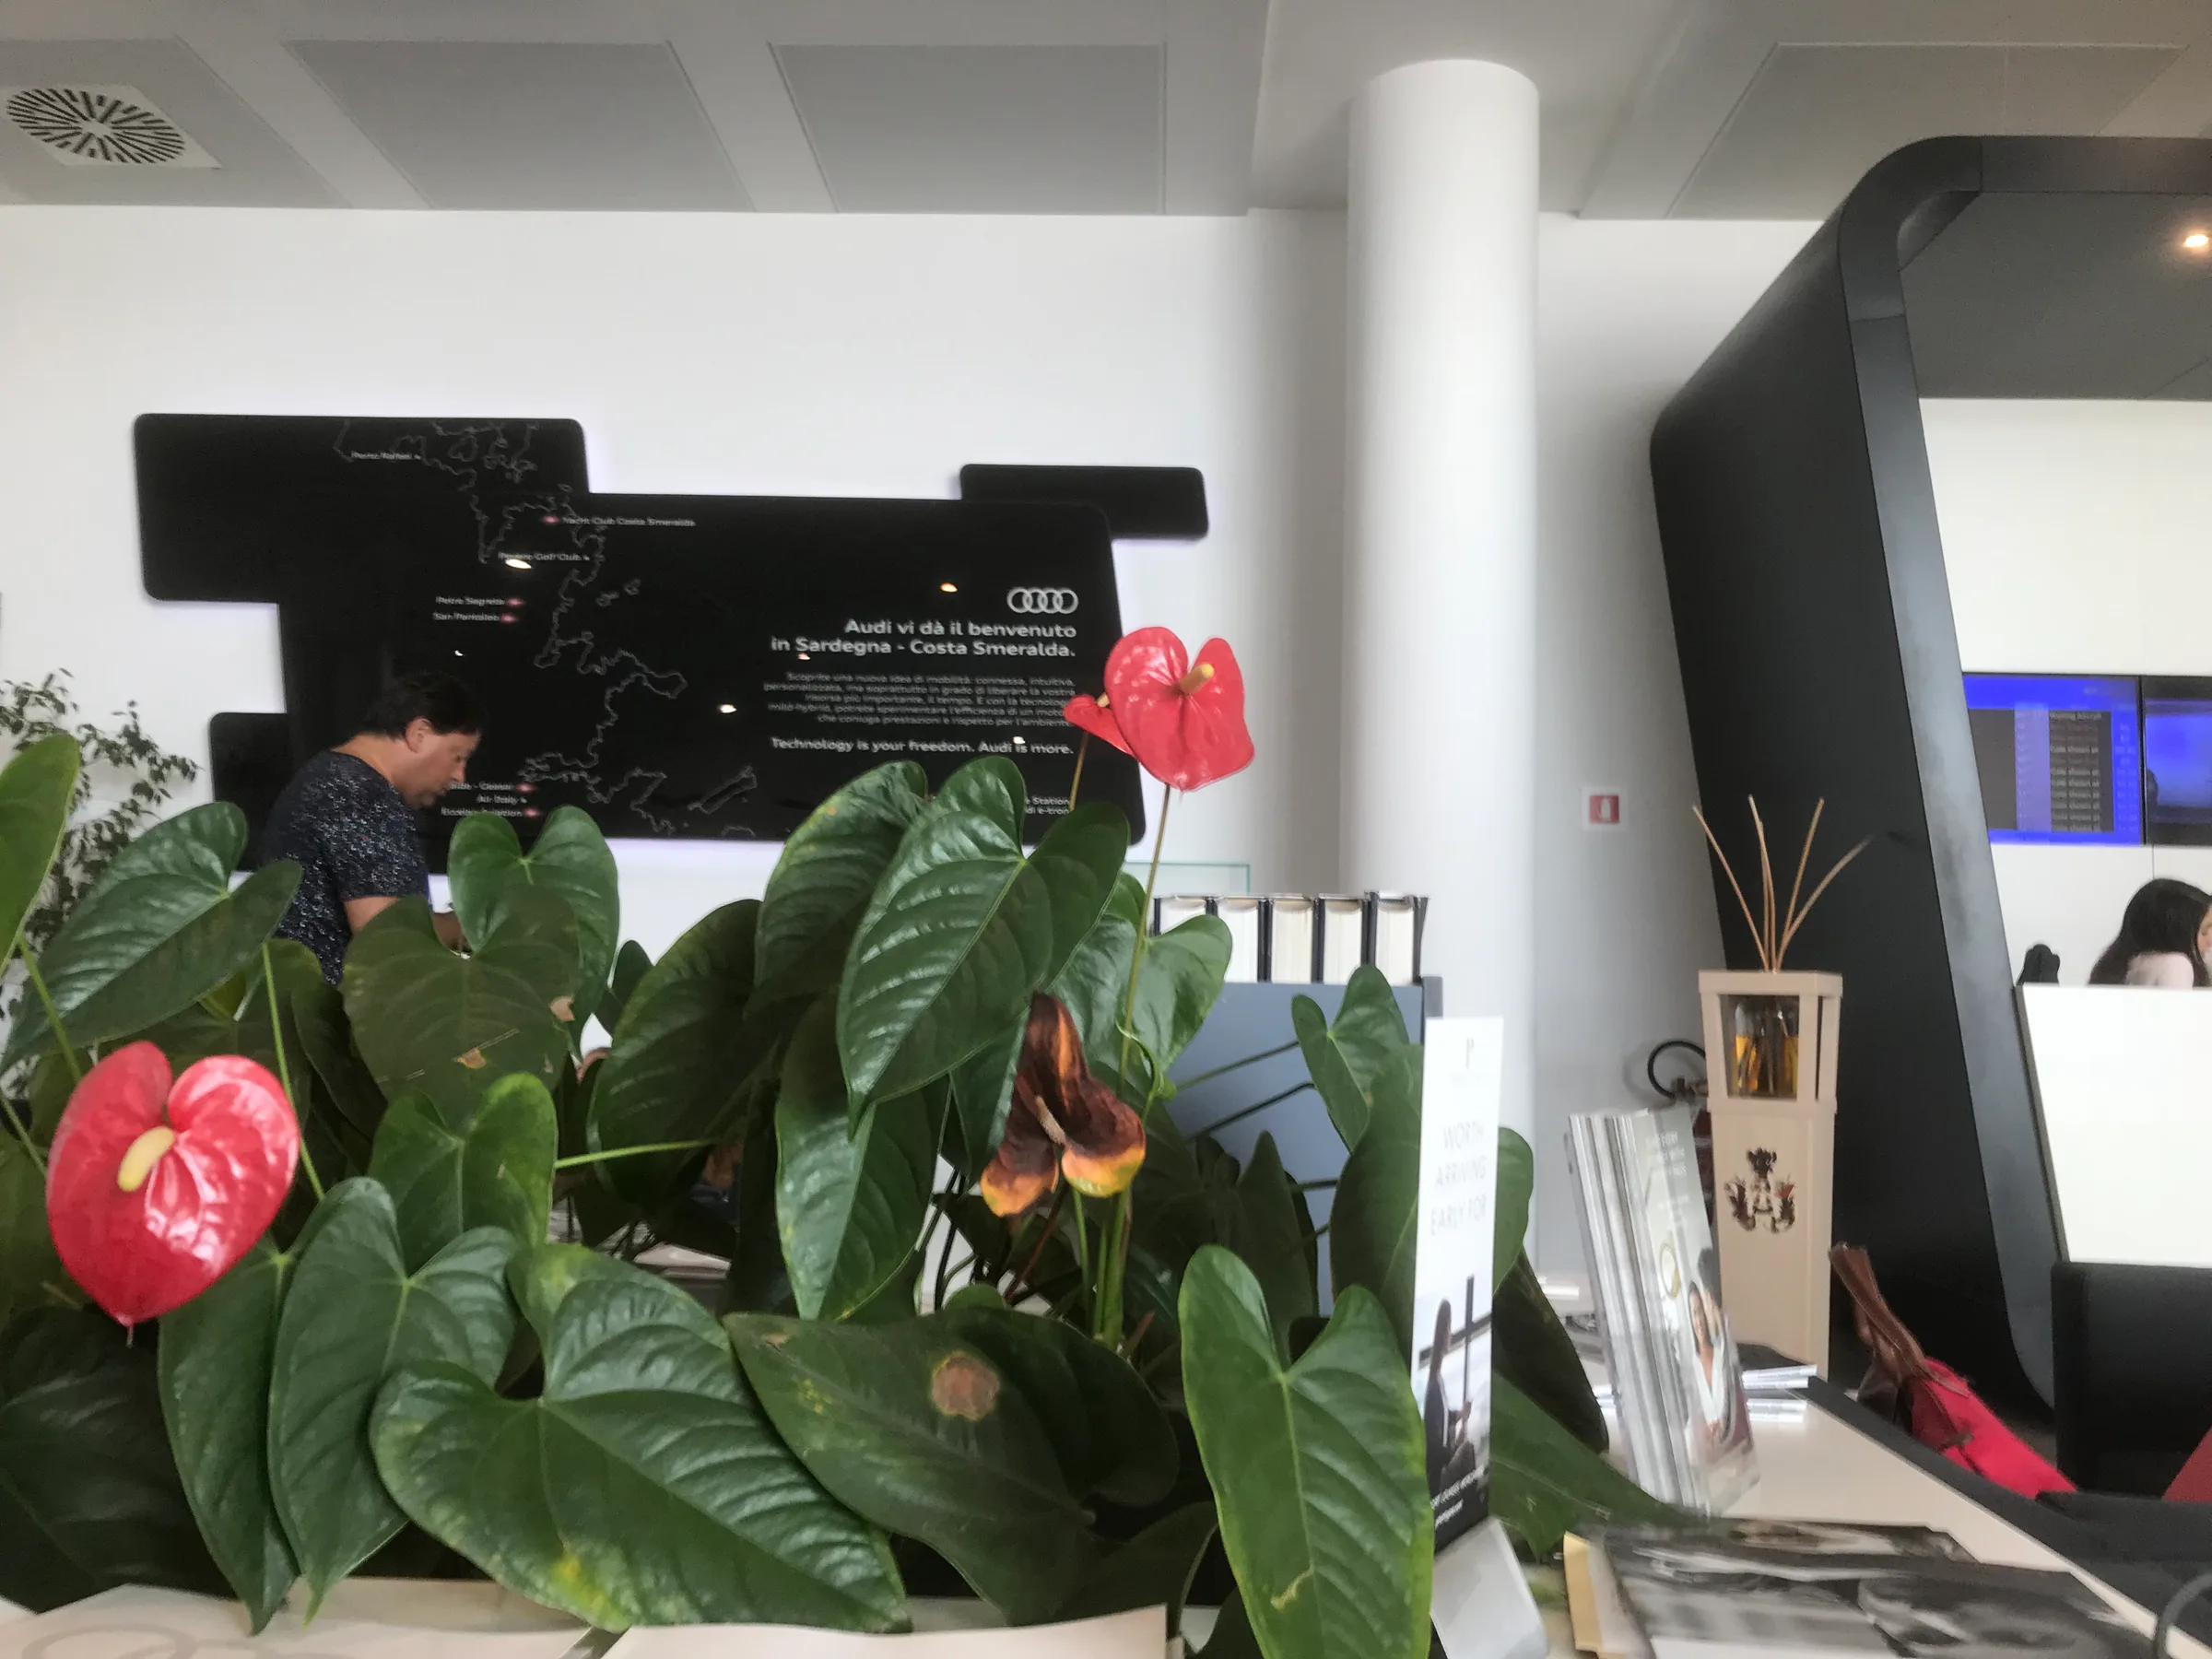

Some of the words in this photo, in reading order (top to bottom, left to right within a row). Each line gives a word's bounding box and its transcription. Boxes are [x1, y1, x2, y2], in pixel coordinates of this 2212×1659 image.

[844, 618, 893, 635] Audi
[897, 620, 914, 635] vi
[920, 619, 945, 636] dà
[949, 620, 963, 636] il
[969, 622, 1077, 638] benvenuto
[771, 636, 790, 652] in
[795, 636, 892, 656] Sardegna
[910, 640, 968, 655] Costa
[973, 641, 1076, 657] Smeralda.
[771, 736, 854, 753] Technology
[857, 738, 869, 751] is
[873, 741, 904, 754] your
[909, 739, 975, 753] freedom.
[979, 741, 1013, 754] Audi
[1016, 741, 1028, 754] is
[1031, 743, 1075, 755] more.
[1031, 795, 1070, 806] Station
[1037, 806, 1070, 815] e-tron
[1442, 1122, 1483, 1149] WORTH
[1436, 1157, 1487, 1187] ARRIVING
[1430, 1203, 1465, 1236] EARLY
